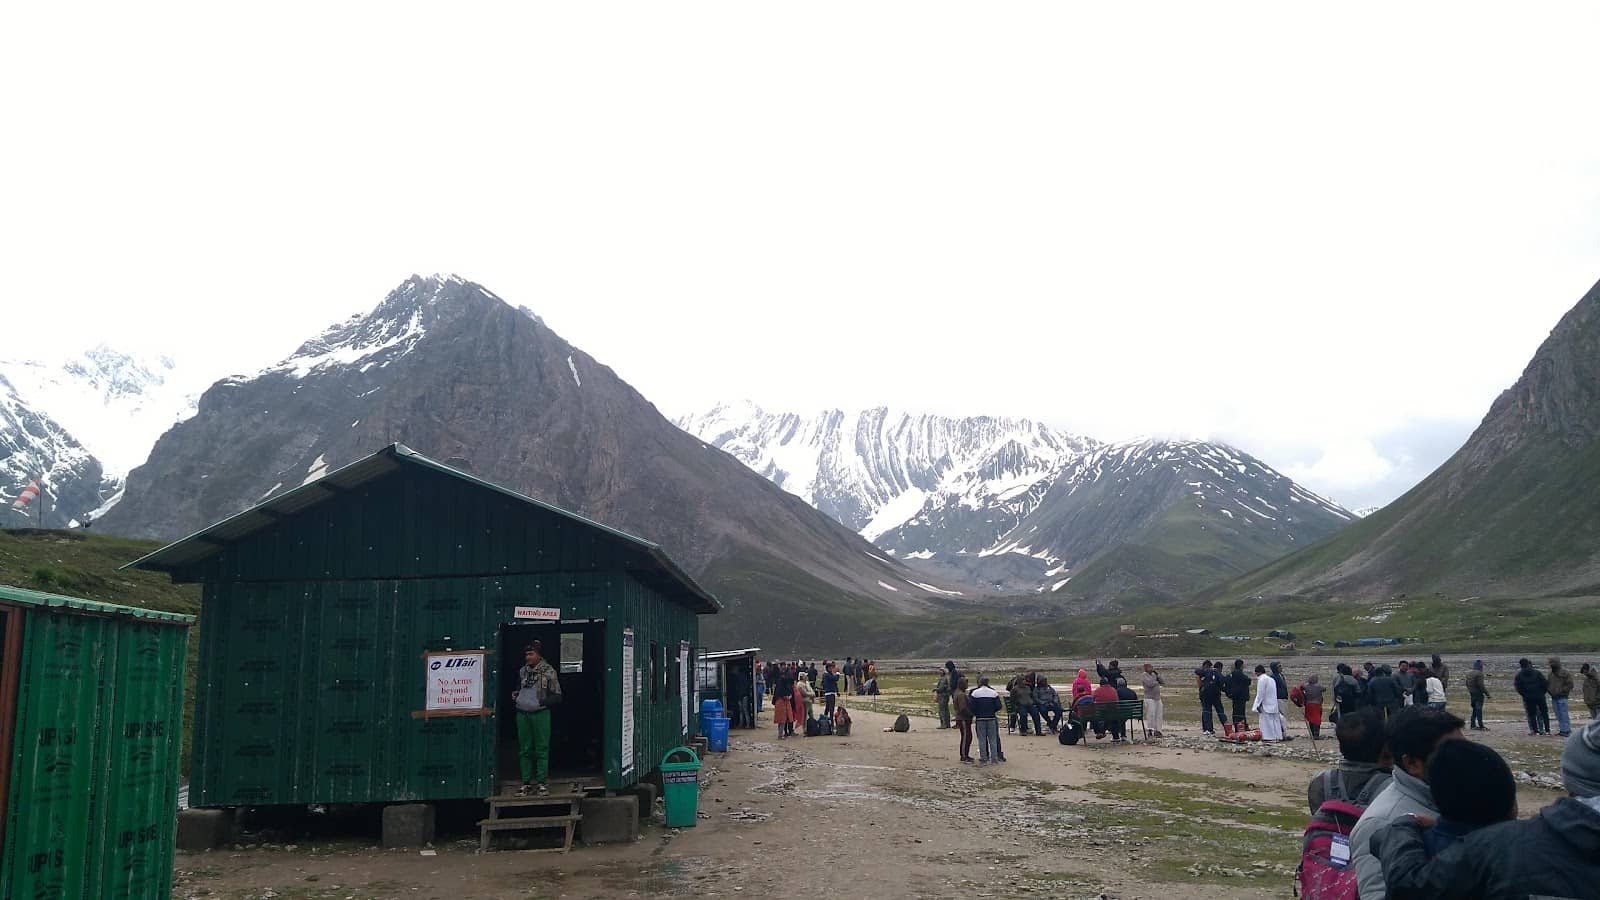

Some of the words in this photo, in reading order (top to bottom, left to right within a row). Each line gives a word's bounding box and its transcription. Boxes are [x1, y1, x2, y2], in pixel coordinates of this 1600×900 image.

[445, 657, 477, 668] UTair
[437, 678, 449, 686] No
[451, 677, 473, 685] Arms
[441, 686, 469, 696] beyond
[437, 697, 451, 705] this
[453, 696, 472, 705] point
